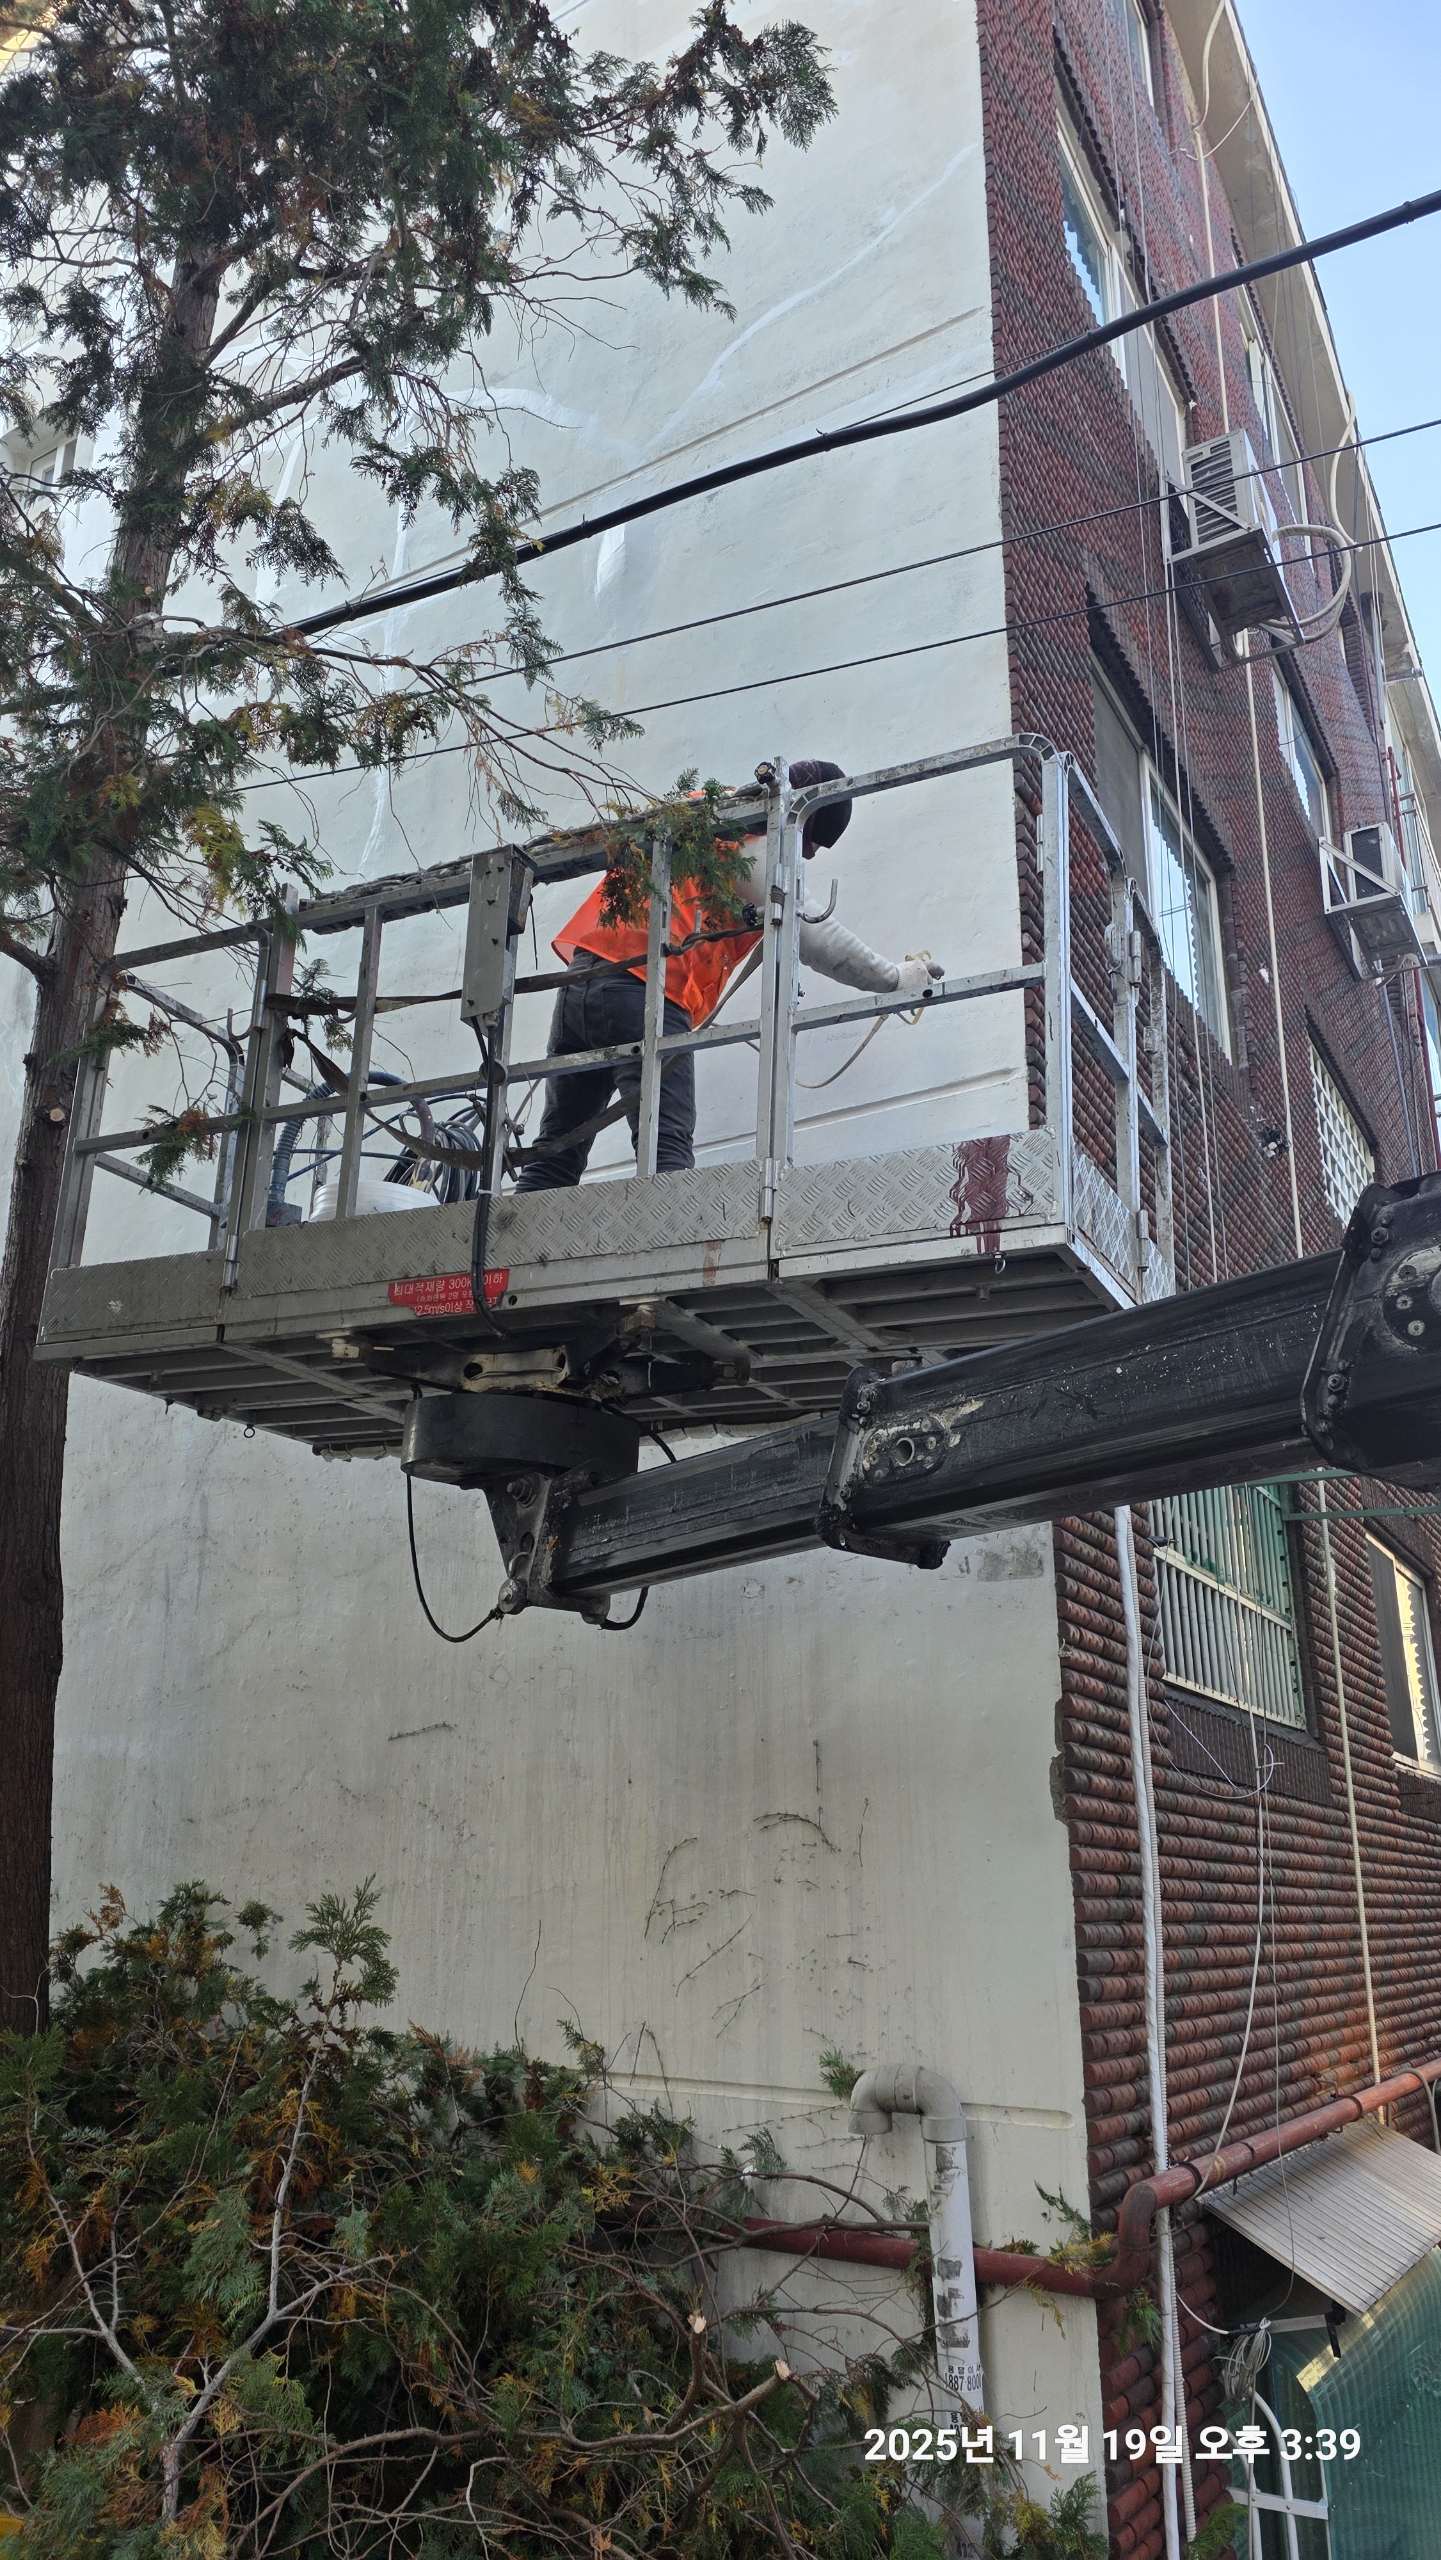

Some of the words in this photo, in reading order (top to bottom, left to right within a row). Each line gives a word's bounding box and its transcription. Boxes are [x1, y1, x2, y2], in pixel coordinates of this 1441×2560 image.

[394, 1280, 446, 1296] 최대적재량
[448, 1278, 474, 1290] 300k
[483, 1273, 503, 1285] 이하
